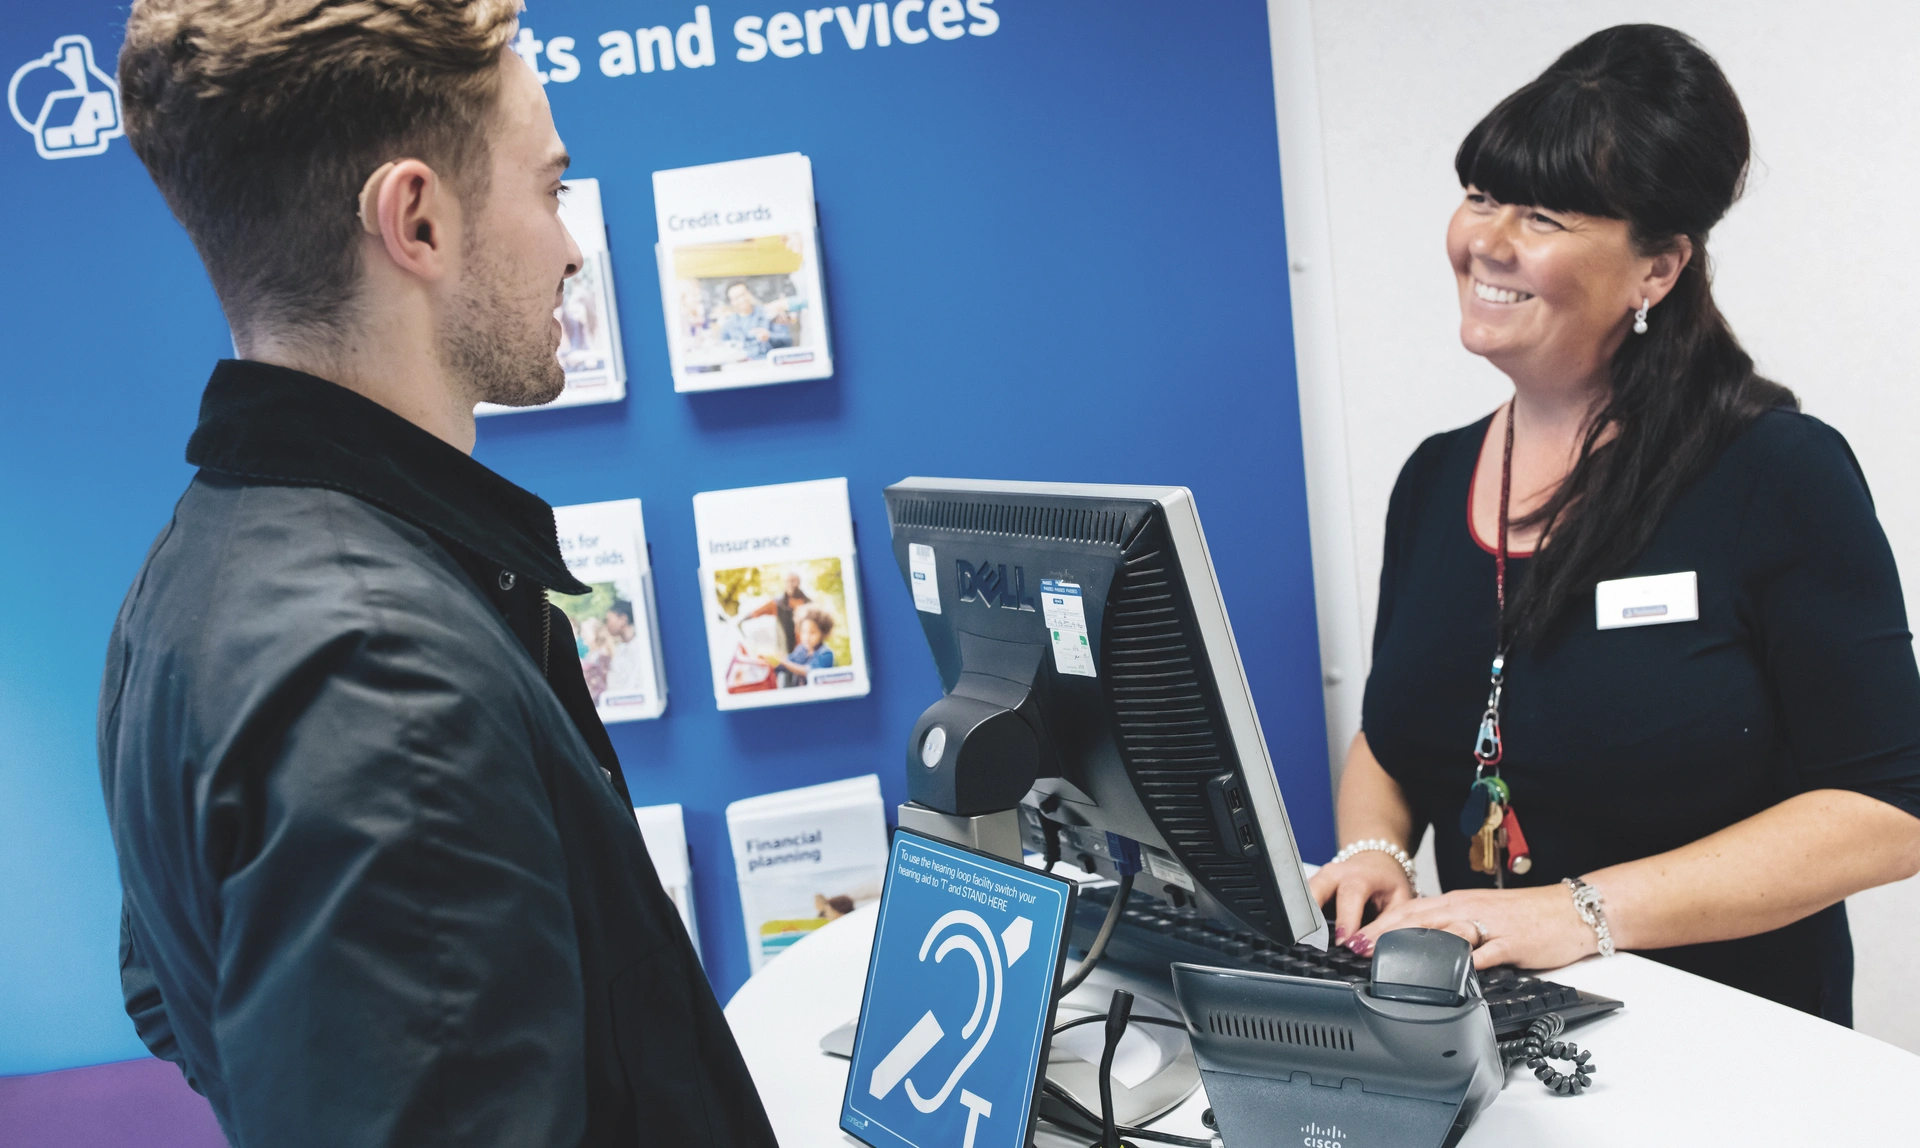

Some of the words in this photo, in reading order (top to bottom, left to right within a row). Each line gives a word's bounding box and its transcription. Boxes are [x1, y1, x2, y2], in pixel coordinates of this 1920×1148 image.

[520, 27, 580, 85] ts
[599, 6, 716, 77] and
[734, 0, 1000, 62] services
[668, 212, 720, 231] Credit
[726, 205, 772, 225] cards
[578, 533, 599, 548] for
[709, 534, 791, 554] Insurance
[564, 556, 588, 568] ear
[595, 551, 624, 566] olds
[956, 559, 1036, 612] DELL
[747, 830, 822, 853] Financial
[748, 848, 822, 872] planning
[898, 864, 921, 884] hearing
[921, 872, 932, 885] aid
[931, 876, 939, 888] to
[948, 884, 962, 896] and
[961, 885, 988, 905] STAND
[987, 895, 1008, 913] HERE
[901, 849, 909, 861] To
[909, 855, 920, 865] use
[920, 856, 931, 869] the
[931, 859, 956, 880] hearing
[956, 868, 972, 884] loop
[972, 873, 994, 892] facility
[994, 883, 1018, 899] switch
[1018, 891, 1037, 905] your
[845, 1114, 865, 1130] contacta
